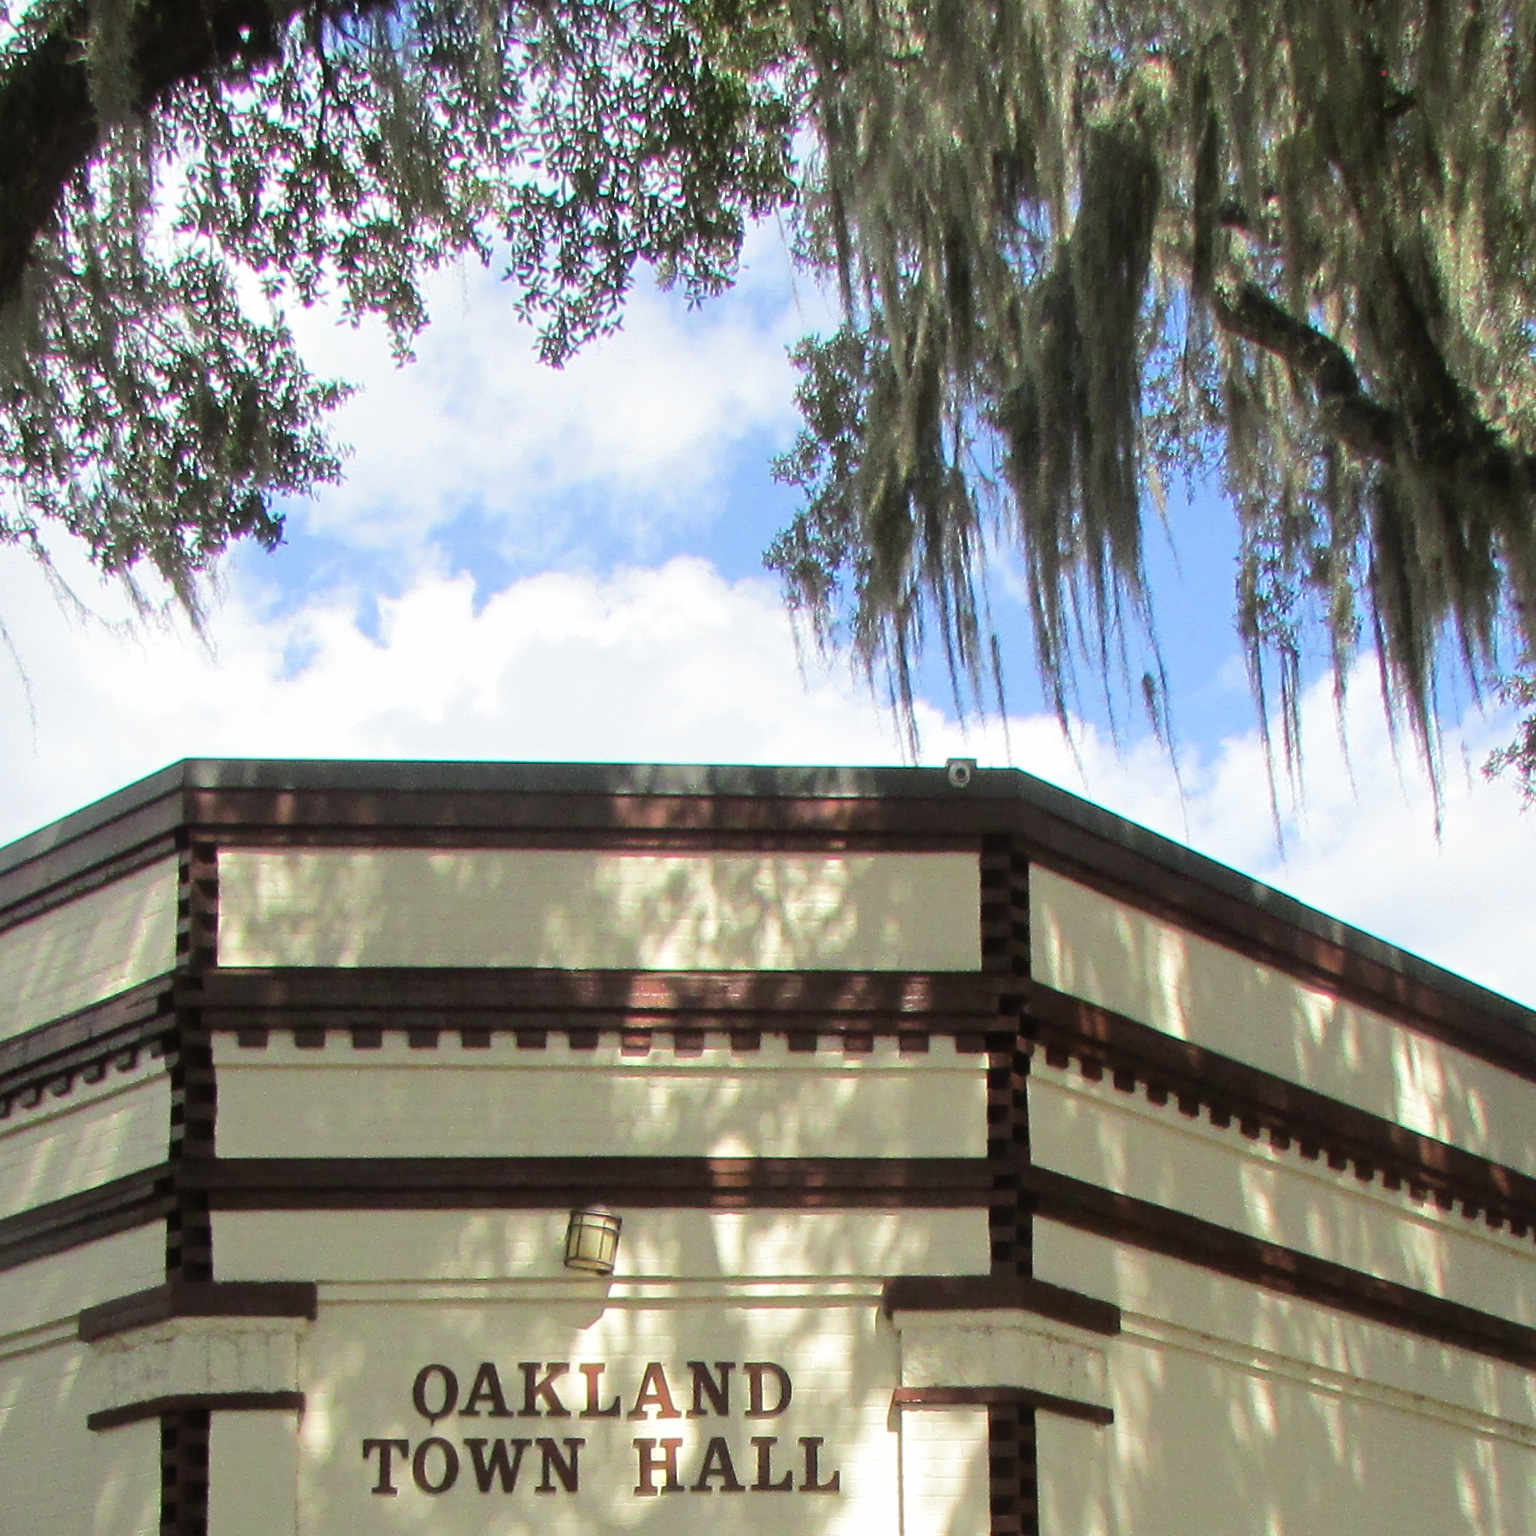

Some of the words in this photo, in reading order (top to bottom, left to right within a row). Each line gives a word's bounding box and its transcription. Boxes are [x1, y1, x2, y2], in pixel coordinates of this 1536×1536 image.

[412, 1361, 794, 1427] OAKLAND
[363, 1437, 586, 1496] TOWN
[632, 1436, 841, 1497] HALL
